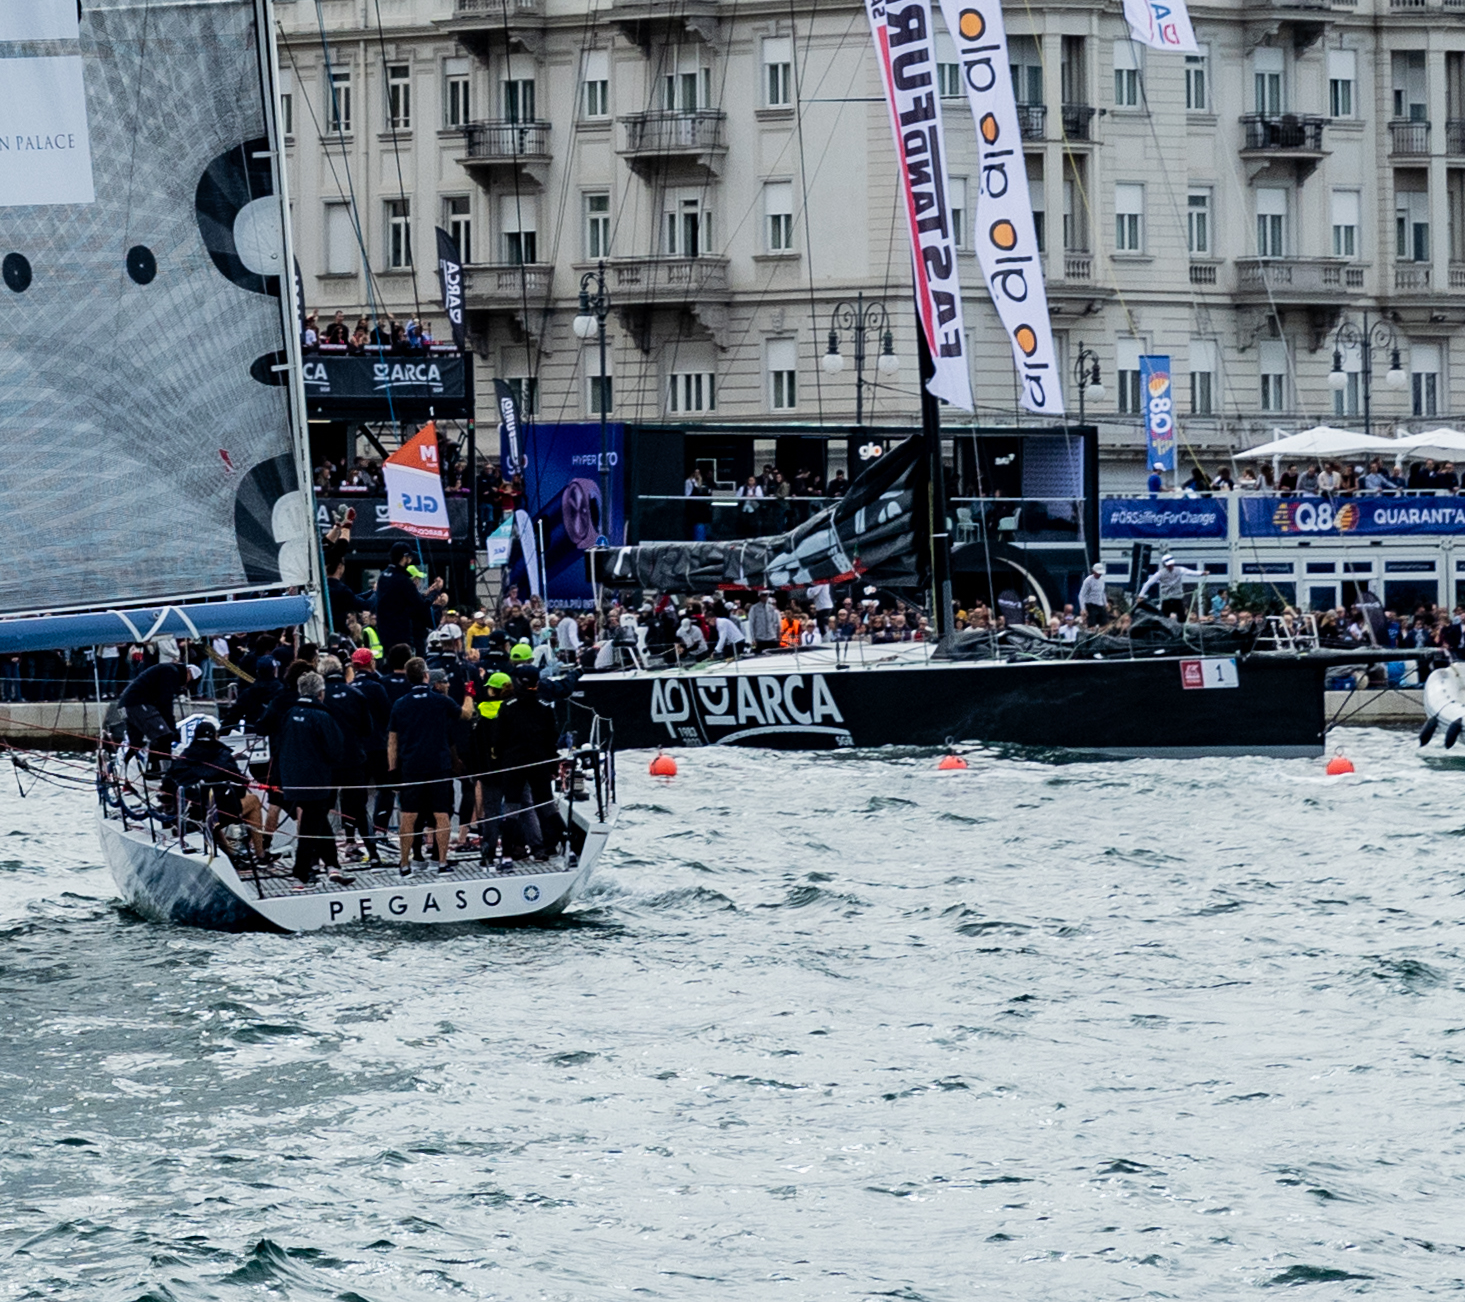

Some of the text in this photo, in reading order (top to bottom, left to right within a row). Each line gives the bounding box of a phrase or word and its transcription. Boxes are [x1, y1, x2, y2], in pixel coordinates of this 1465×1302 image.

[15, 133, 76, 151] PALACE
[303, 362, 329, 380] CA
[390, 363, 441, 382] ARCA
[858, 441, 883, 460] glo
[573, 455, 597, 466] HYPER
[1294, 503, 1332, 532] Q8
[1215, 664, 1224, 682] 1
[736, 673, 845, 726] ARCA
[329, 886, 503, 921] PEGASO
